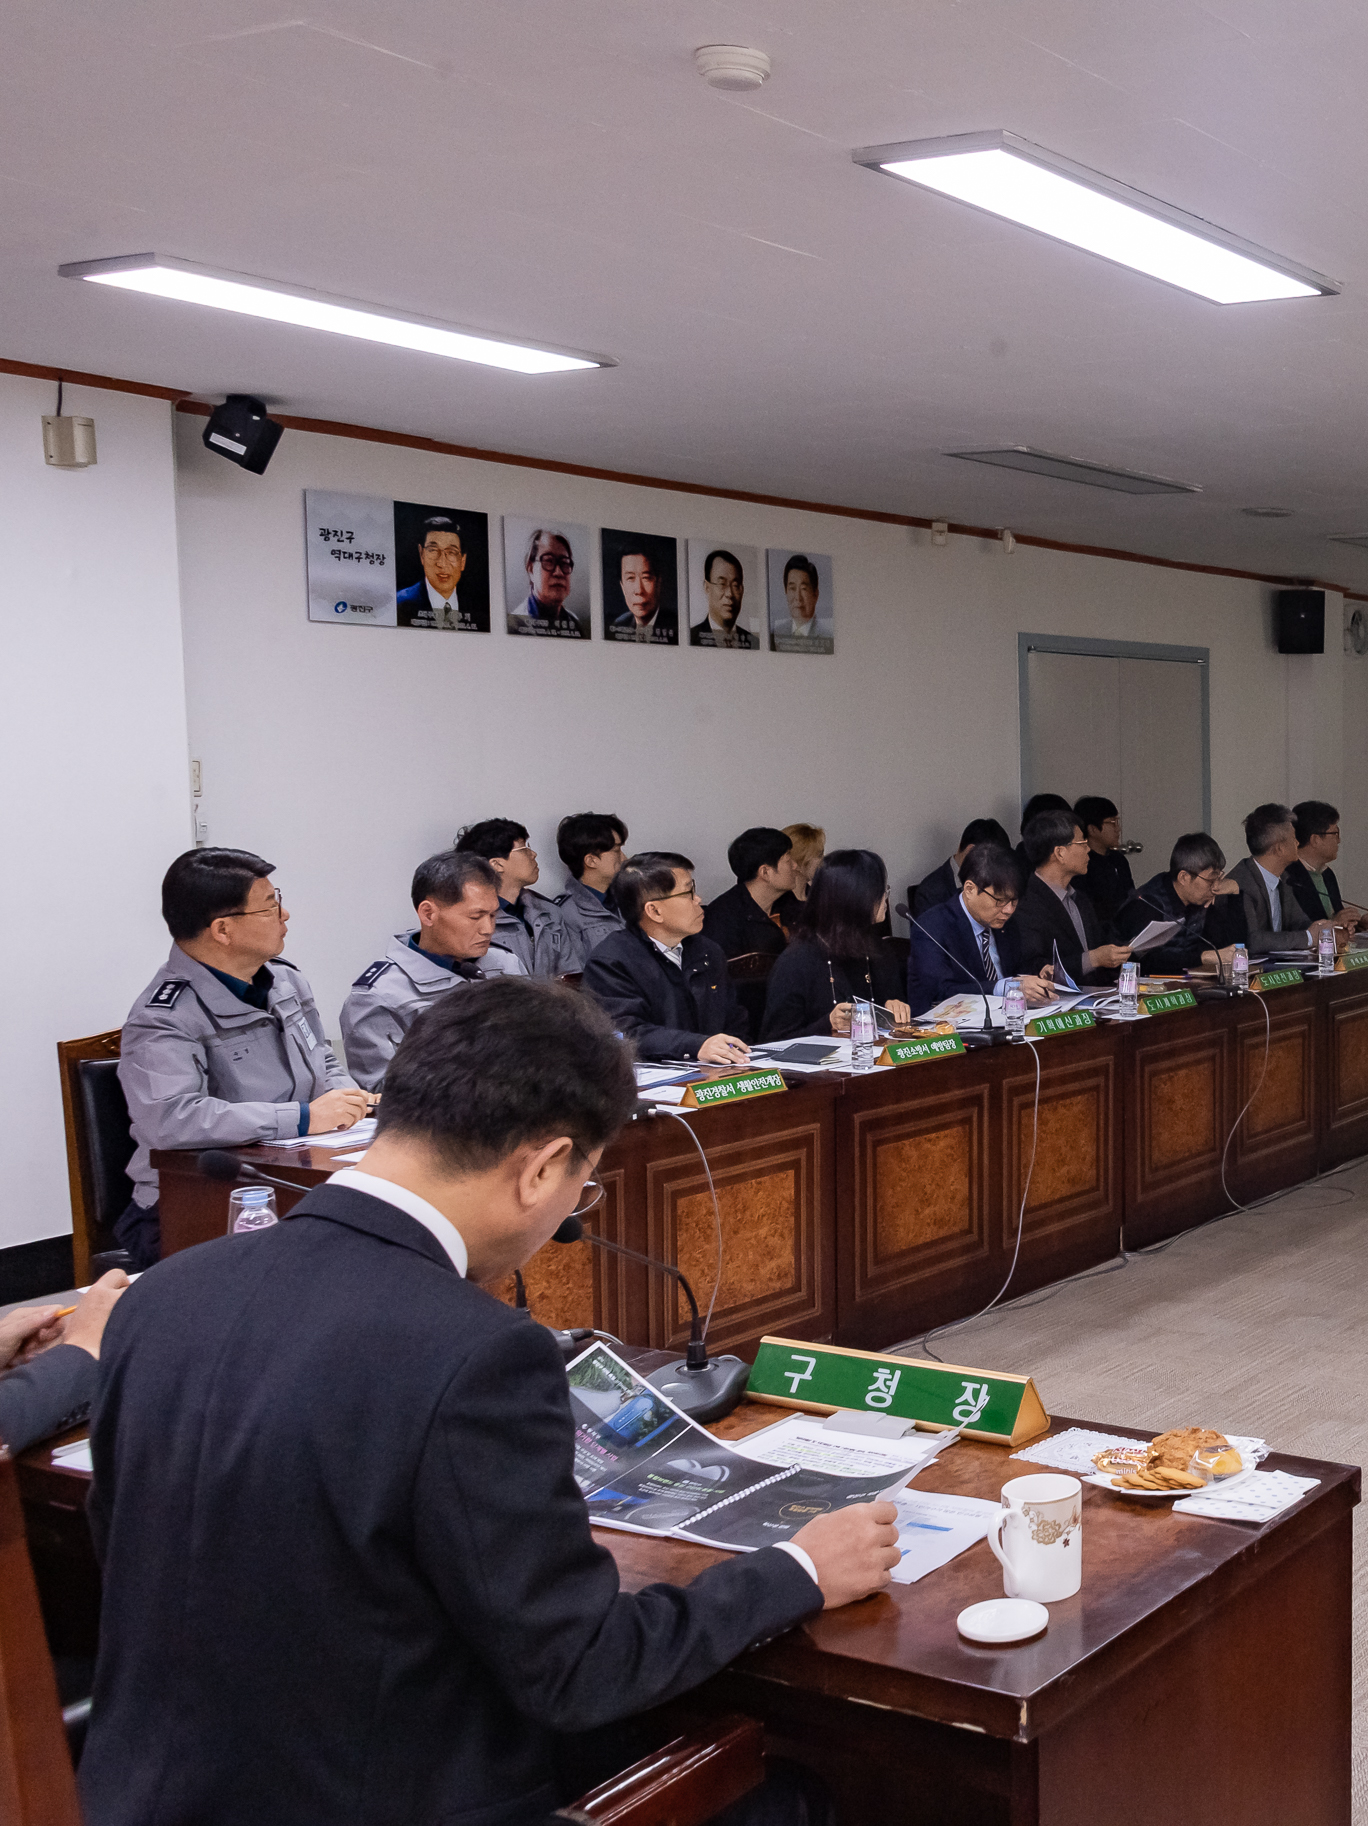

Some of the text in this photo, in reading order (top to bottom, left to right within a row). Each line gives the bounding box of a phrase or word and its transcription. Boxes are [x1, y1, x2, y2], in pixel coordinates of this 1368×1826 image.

[319, 528, 355, 544] 광진구
[330, 549, 386, 566] 역대구청장
[350, 604, 373, 613] 광진구
[1036, 1012, 1092, 1033] 기획예산과장
[896, 1038, 957, 1059] 광진소방서 예방팀장
[694, 1073, 782, 1101] 광진경찰서 생활안전계장
[1115, 1467, 1137, 1476] minis
